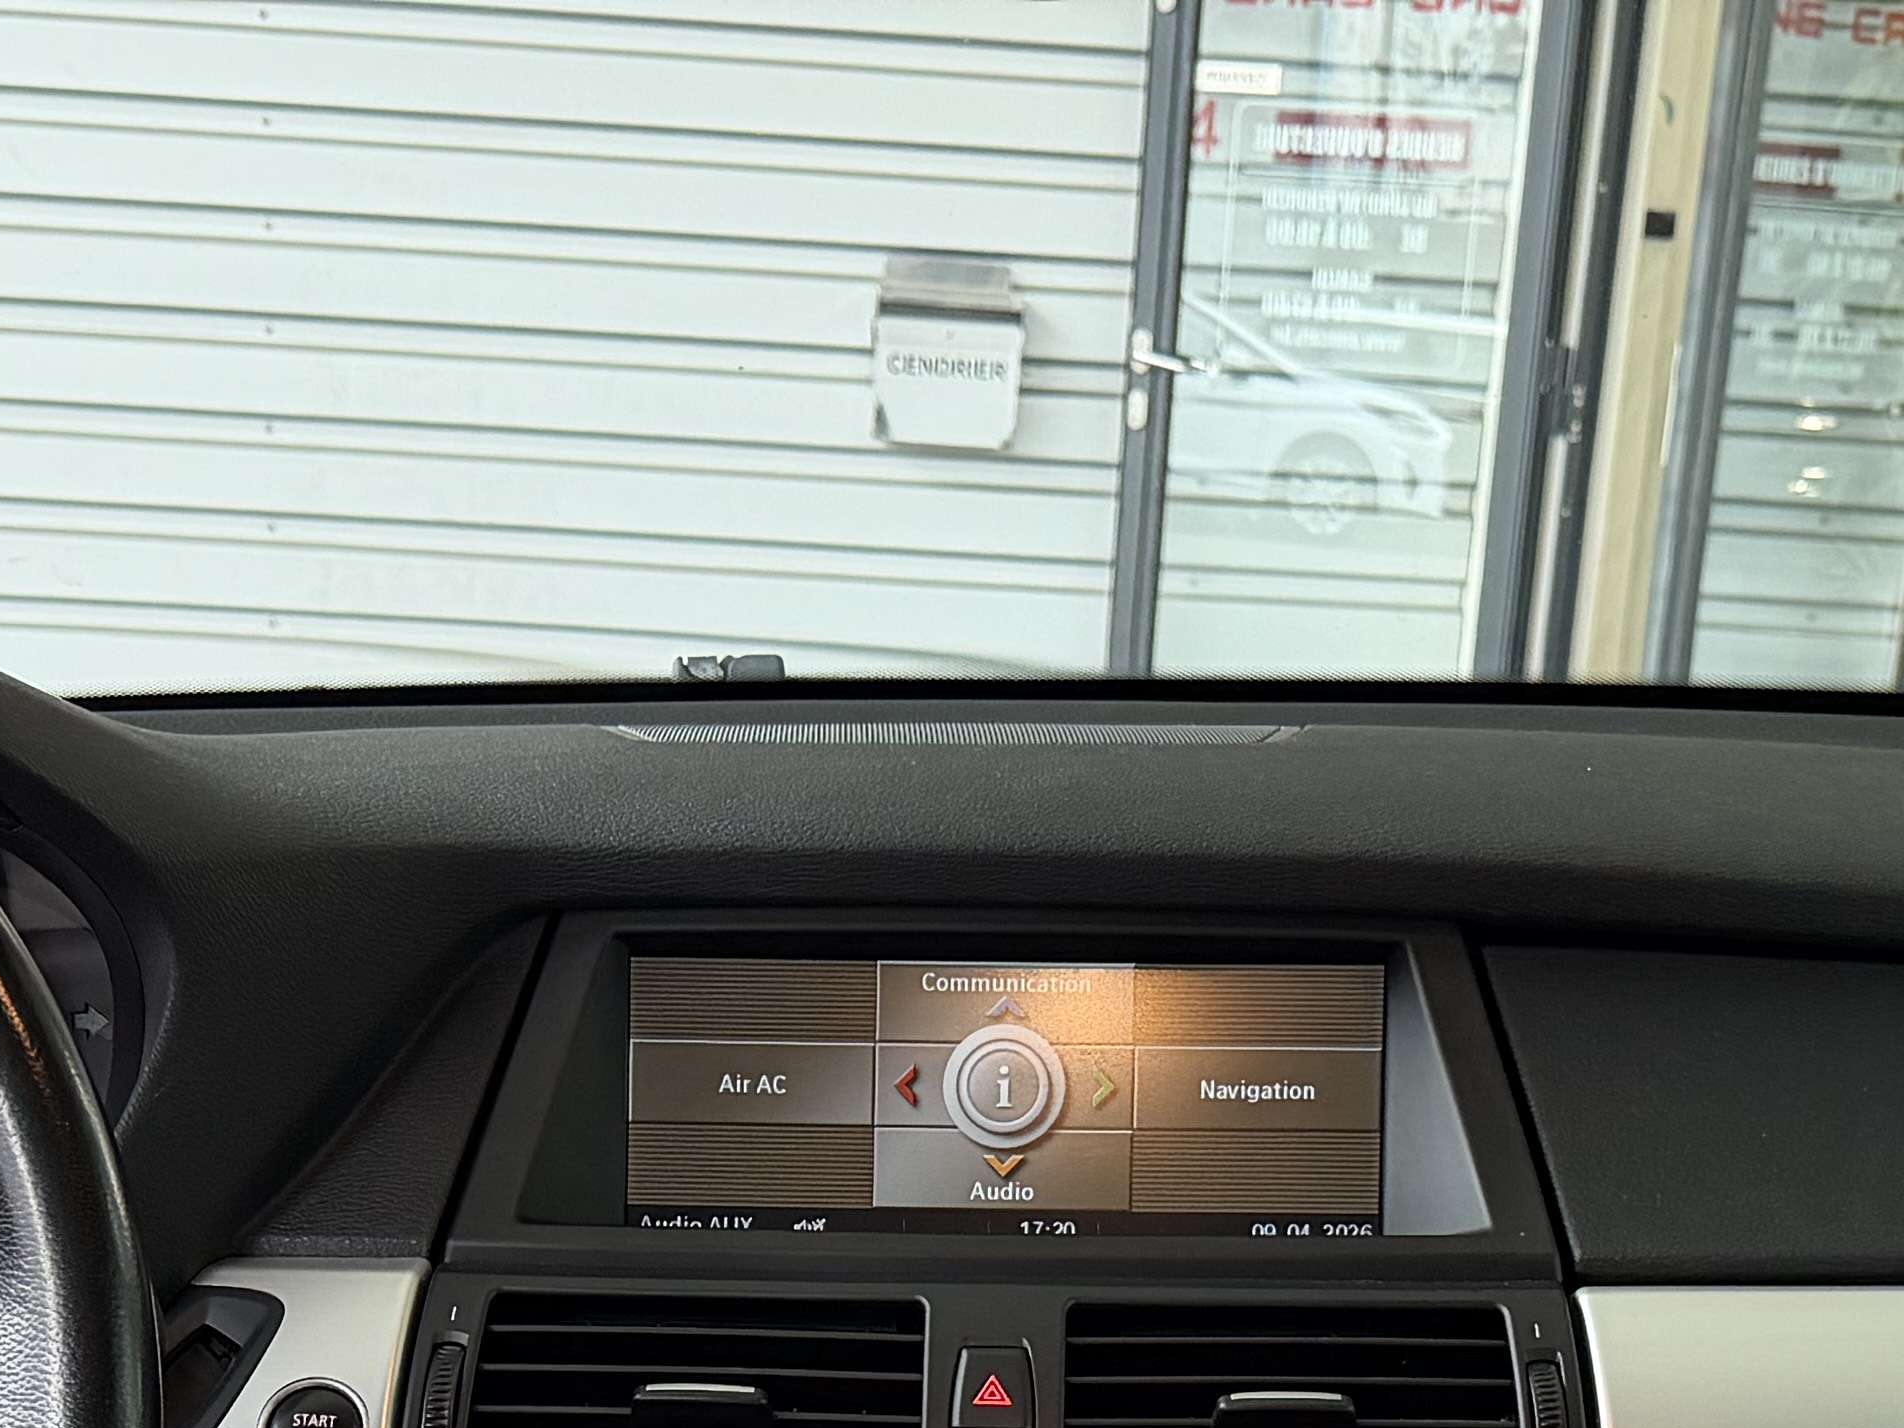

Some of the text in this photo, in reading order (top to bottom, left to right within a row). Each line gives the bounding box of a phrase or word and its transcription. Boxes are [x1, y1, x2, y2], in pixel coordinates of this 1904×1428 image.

[886, 353, 1007, 382] CENDRIER
[921, 972, 1092, 995] Communication
[719, 1074, 787, 1095] Air AC
[1200, 1079, 1315, 1103] Navigation
[970, 1181, 1034, 1201] Audio
[292, 1413, 336, 1428] START
